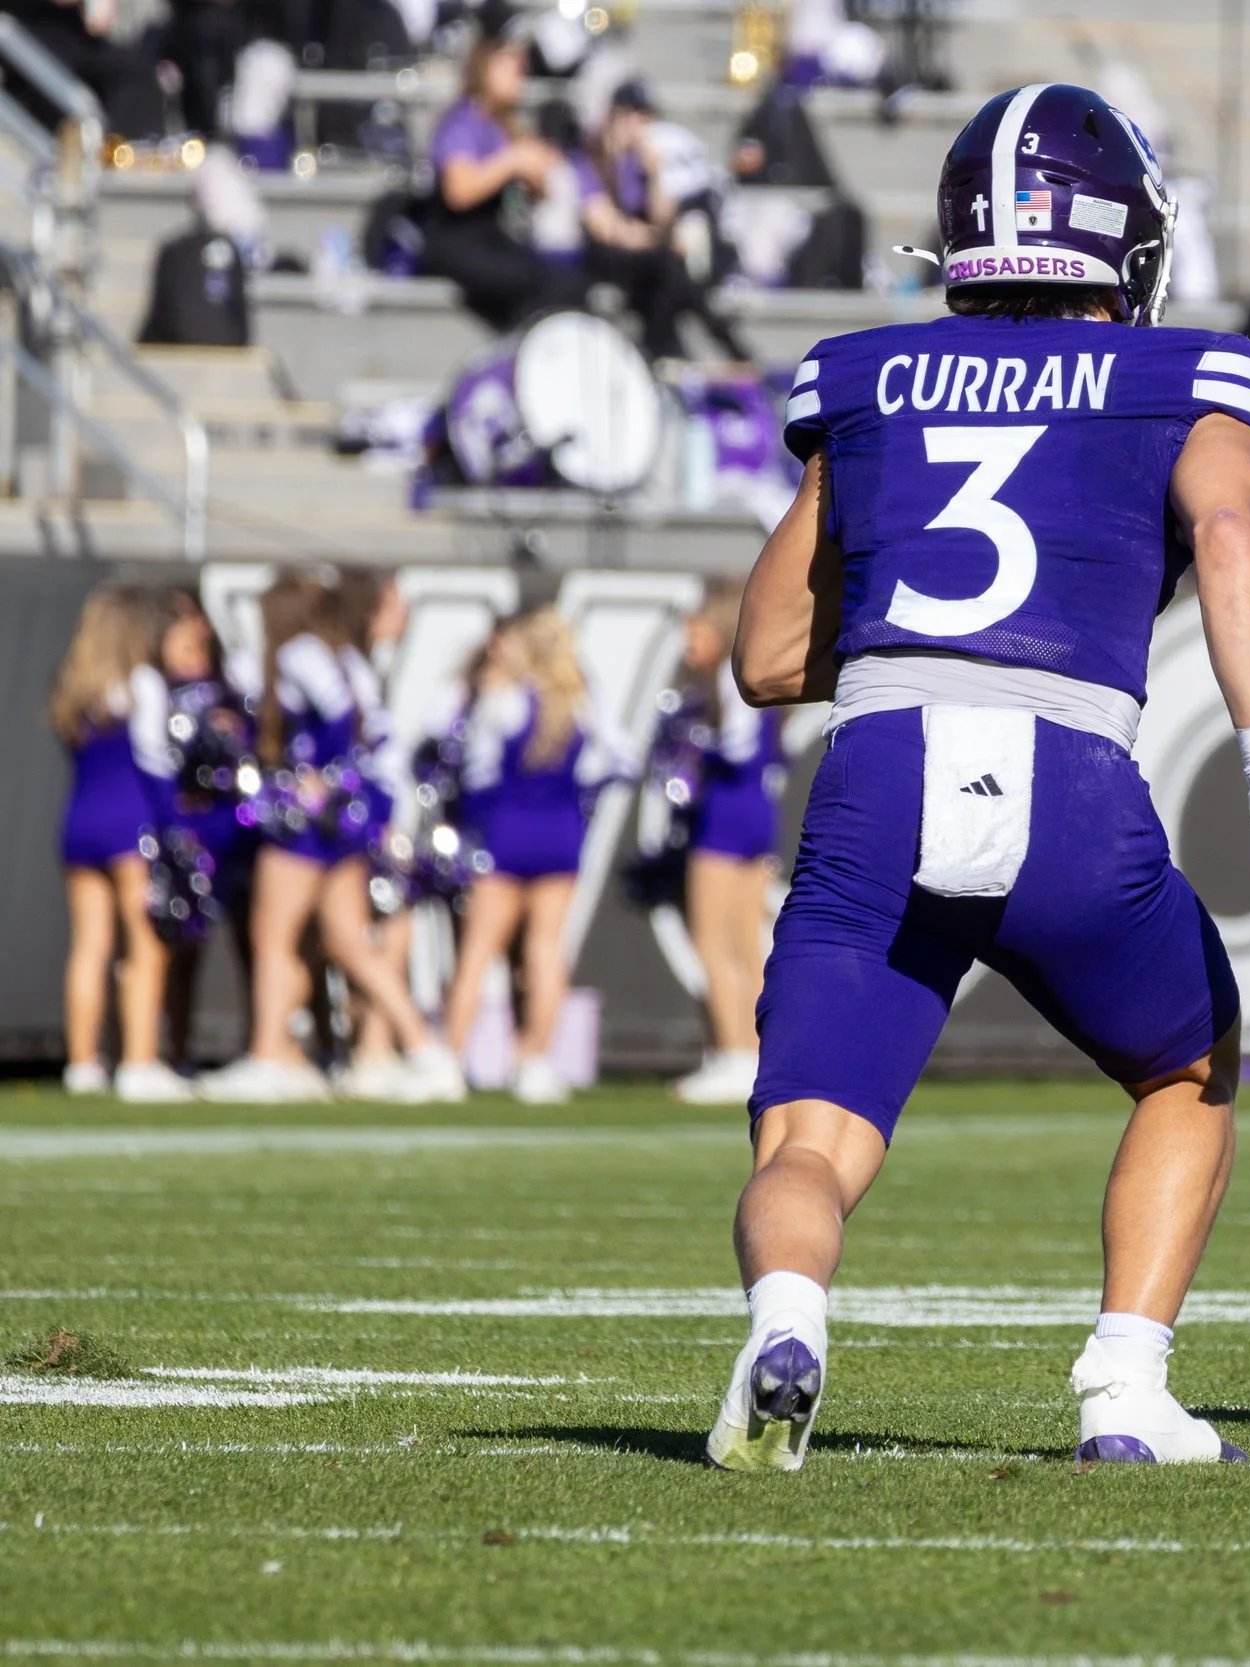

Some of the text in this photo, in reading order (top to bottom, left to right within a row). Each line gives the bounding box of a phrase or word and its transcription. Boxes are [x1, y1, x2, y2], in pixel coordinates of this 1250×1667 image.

[1021, 132, 1040, 155] 3
[947, 257, 1086, 280] CRUSADERS
[877, 353, 1117, 416] CURRAN
[885, 425, 1048, 637] 3
